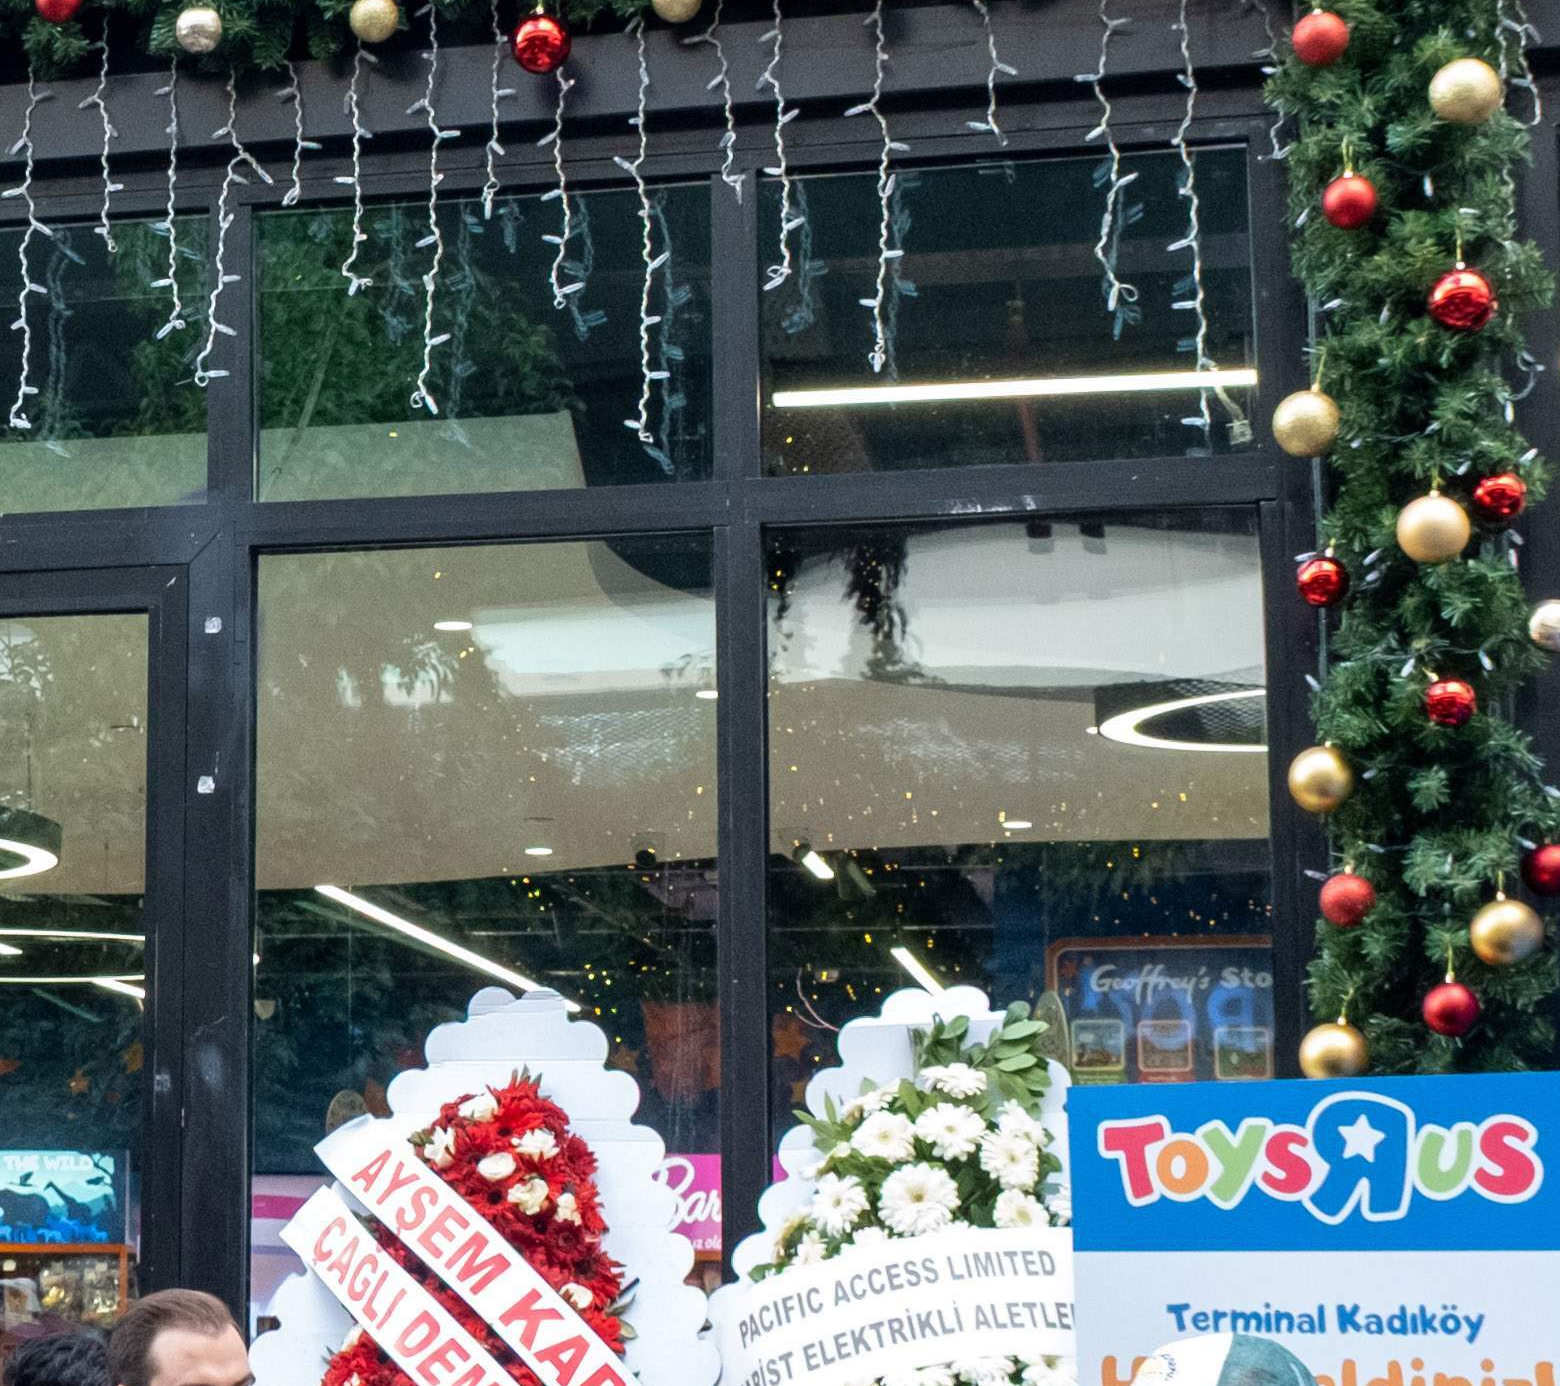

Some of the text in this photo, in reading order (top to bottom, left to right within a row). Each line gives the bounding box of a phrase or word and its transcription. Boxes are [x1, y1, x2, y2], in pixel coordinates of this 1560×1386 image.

[1219, 966, 1274, 990] Sto
[349, 1148, 512, 1297] AYŞEM
[738, 1249, 1057, 1349] PACIFIC ACCESS LIMITED
[1166, 1303, 1485, 1344] Terminal Kadıköy
[802, 1300, 965, 1372] ELEKTRİKLİ
